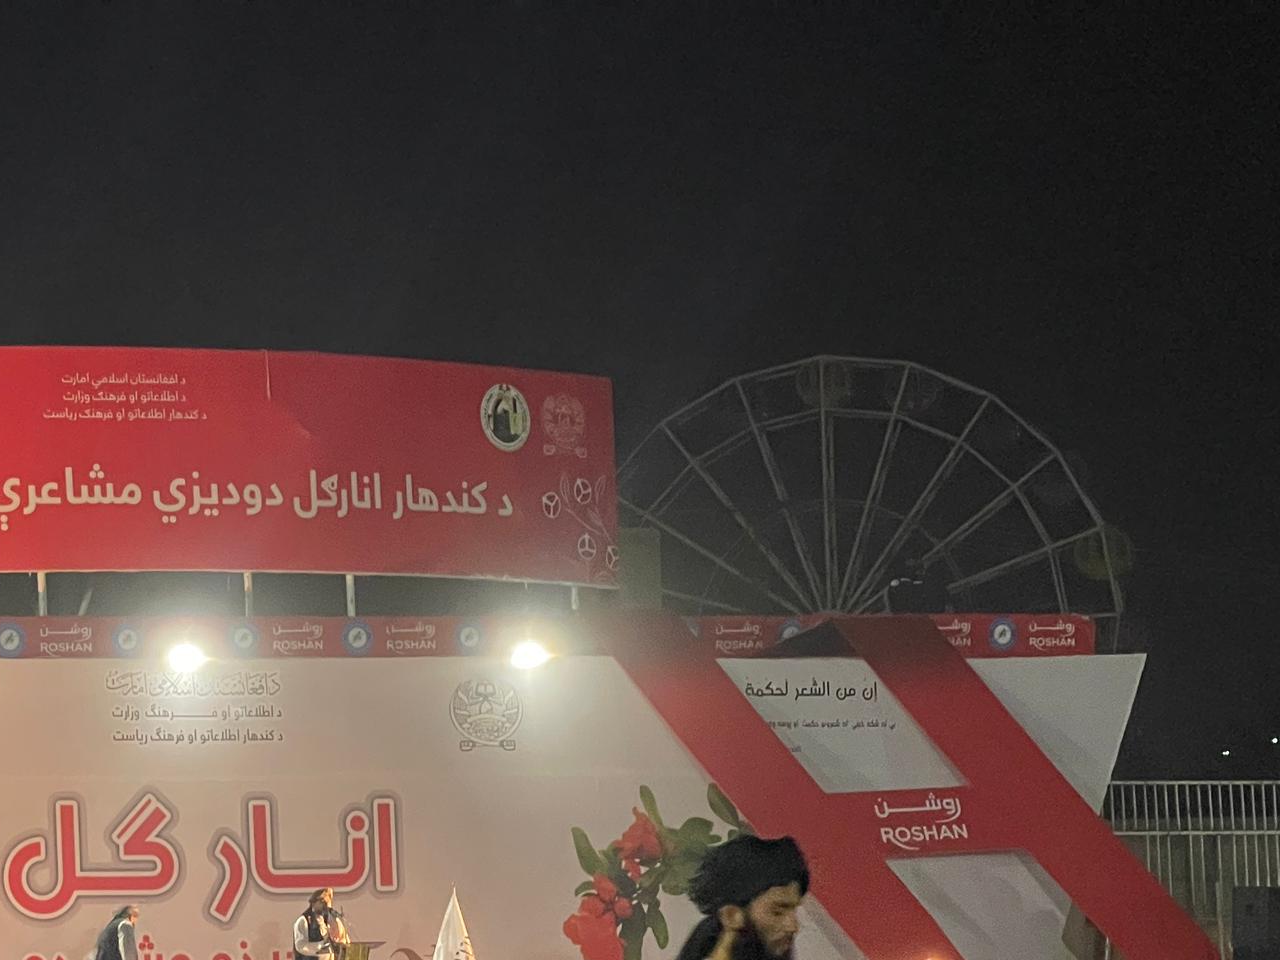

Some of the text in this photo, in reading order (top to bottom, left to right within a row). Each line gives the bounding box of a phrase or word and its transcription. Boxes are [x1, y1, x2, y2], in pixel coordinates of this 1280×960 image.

[61, 372, 90, 386] امارت
[130, 373, 179, 386] افغانستان
[62, 390, 91, 404] وزارت
[129, 390, 138, 404] او
[140, 390, 179, 404] اطلاعاتو
[116, 408, 125, 422] او
[127, 408, 166, 422] اطلاعاتو
[392, 473, 488, 520] کندهار
[497, 493, 514, 517] د
[39, 624, 92, 642] روشن
[272, 622, 323, 640] روشن
[938, 619, 971, 636] روش
[1029, 619, 1076, 637] روشن
[40, 642, 93, 657] ROSHAN
[273, 640, 324, 655] ROSHAN
[386, 639, 437, 654] ROSHAN
[715, 639, 763, 654] ROSHAN
[1029, 637, 1076, 651] ROSHAN
[835, 686, 856, 701] من
[111, 704, 140, 721] وزارت
[221, 705, 231, 721] او
[233, 705, 274, 721] اطلاعاتو
[277, 709, 283, 718] د
[187, 729, 197, 745] او
[200, 729, 240, 745] اطلاعاتو
[243, 729, 274, 744] کندهار
[278, 734, 284, 742] د
[874, 792, 962, 824] روشن
[879, 824, 969, 851] ROSHAN
[210, 798, 399, 922] انار
